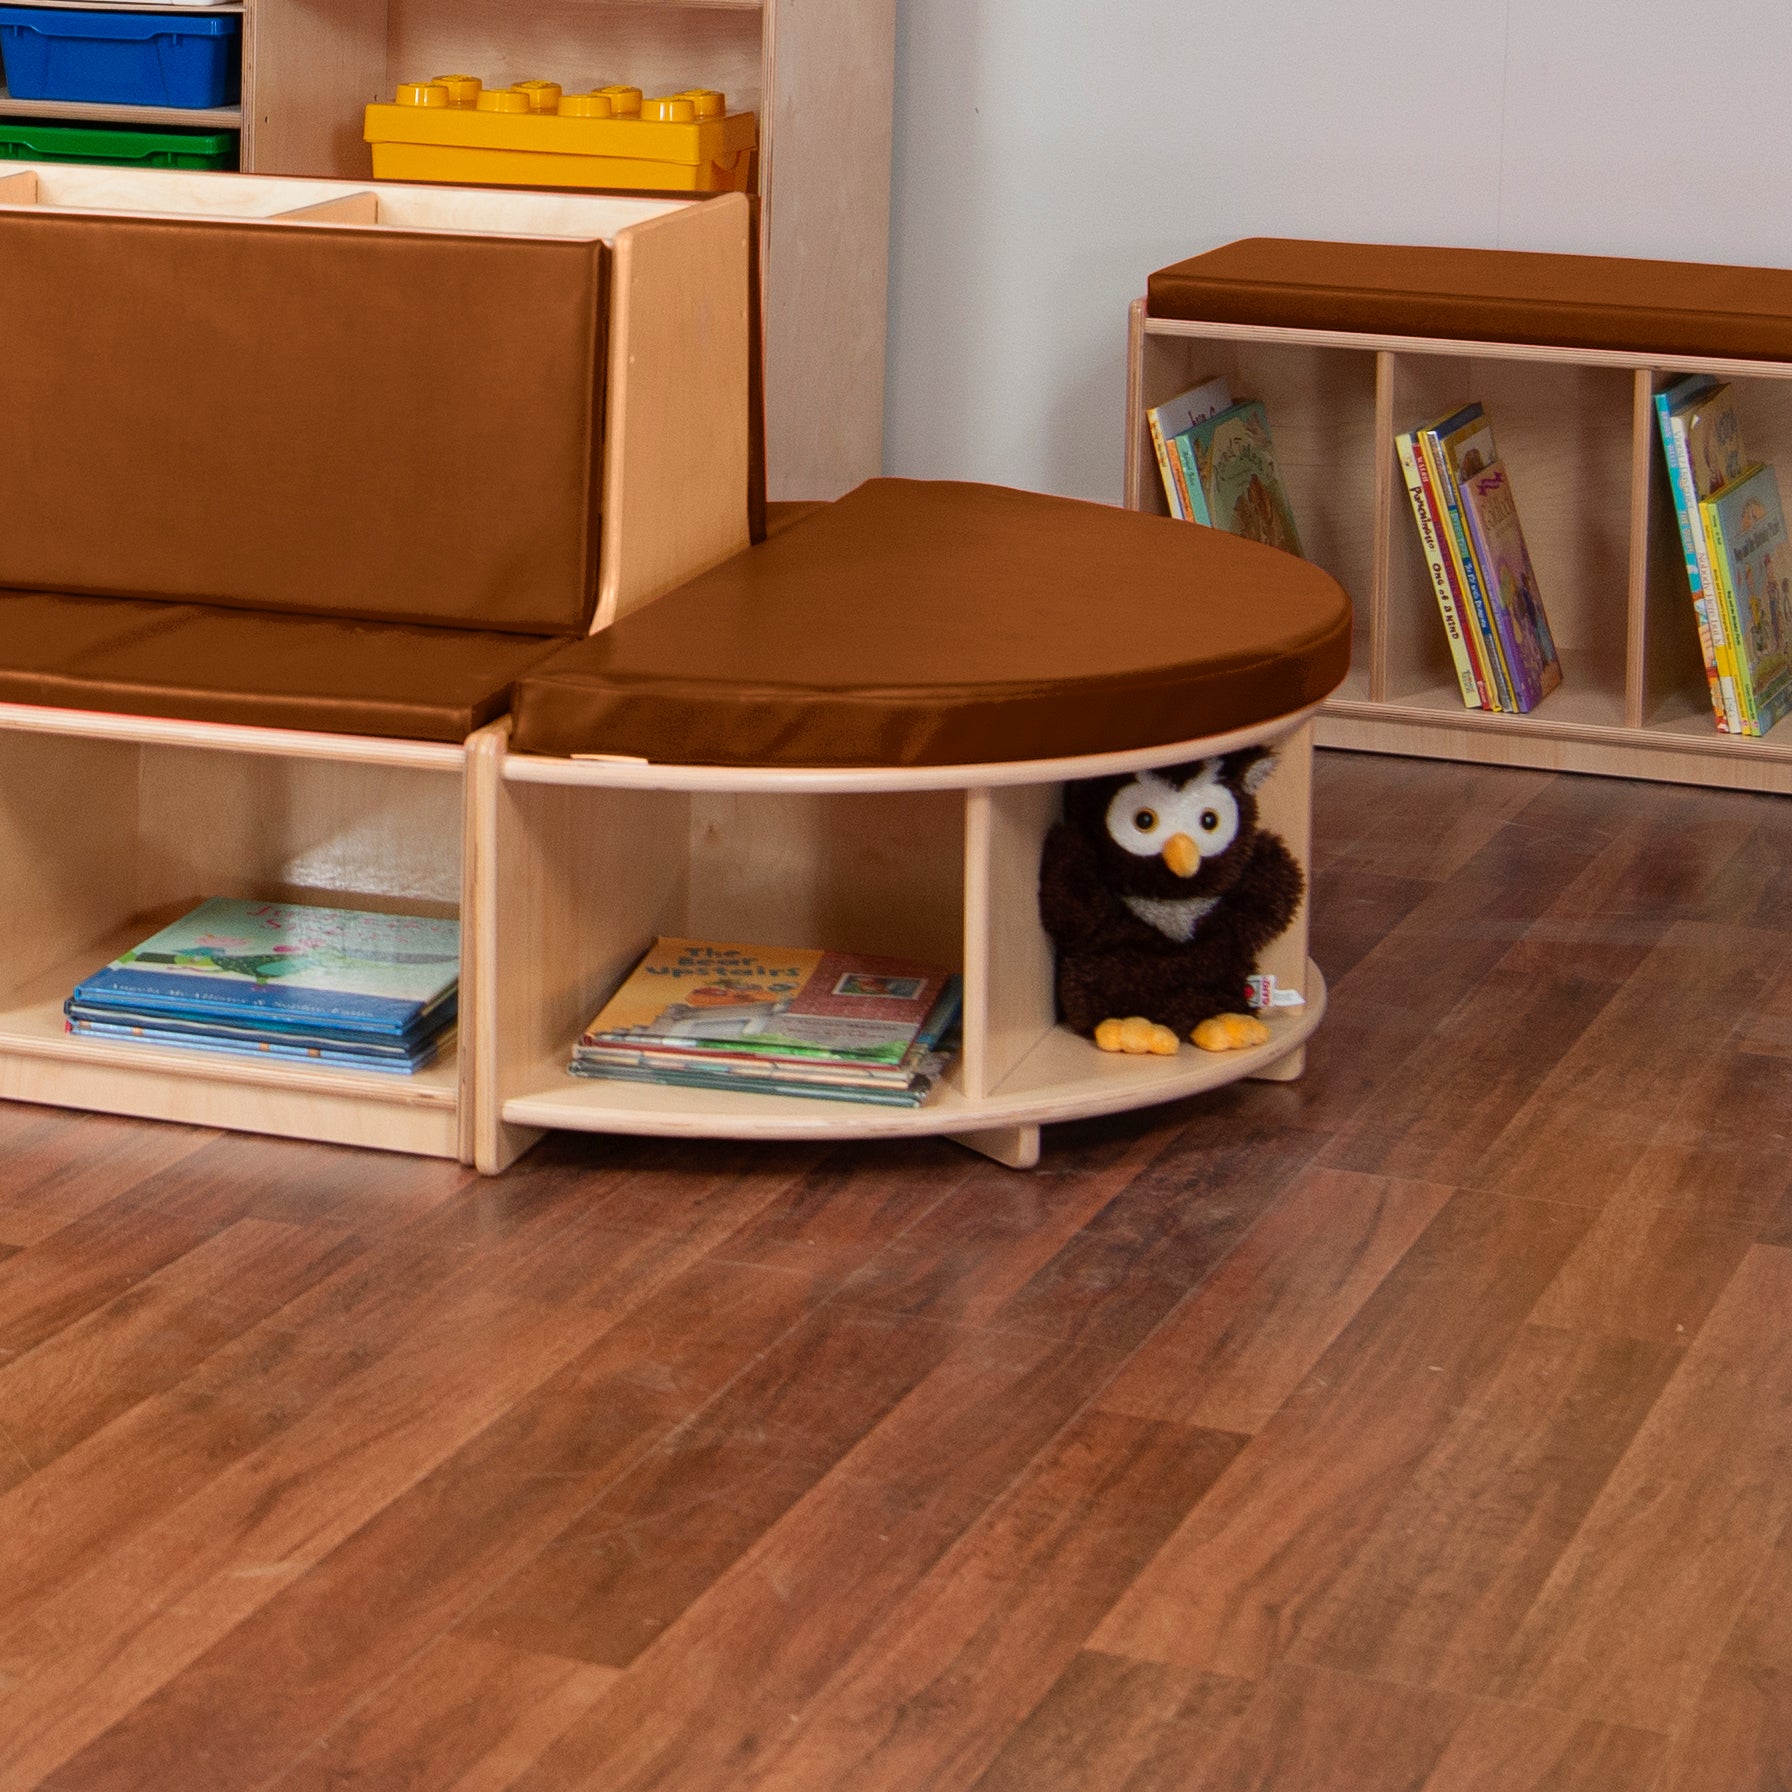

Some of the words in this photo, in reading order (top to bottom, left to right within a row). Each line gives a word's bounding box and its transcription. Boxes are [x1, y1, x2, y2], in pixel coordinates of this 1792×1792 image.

[684, 946, 741, 957] The
[678, 957, 754, 966] Bear
[645, 965, 801, 978] Upstairs
